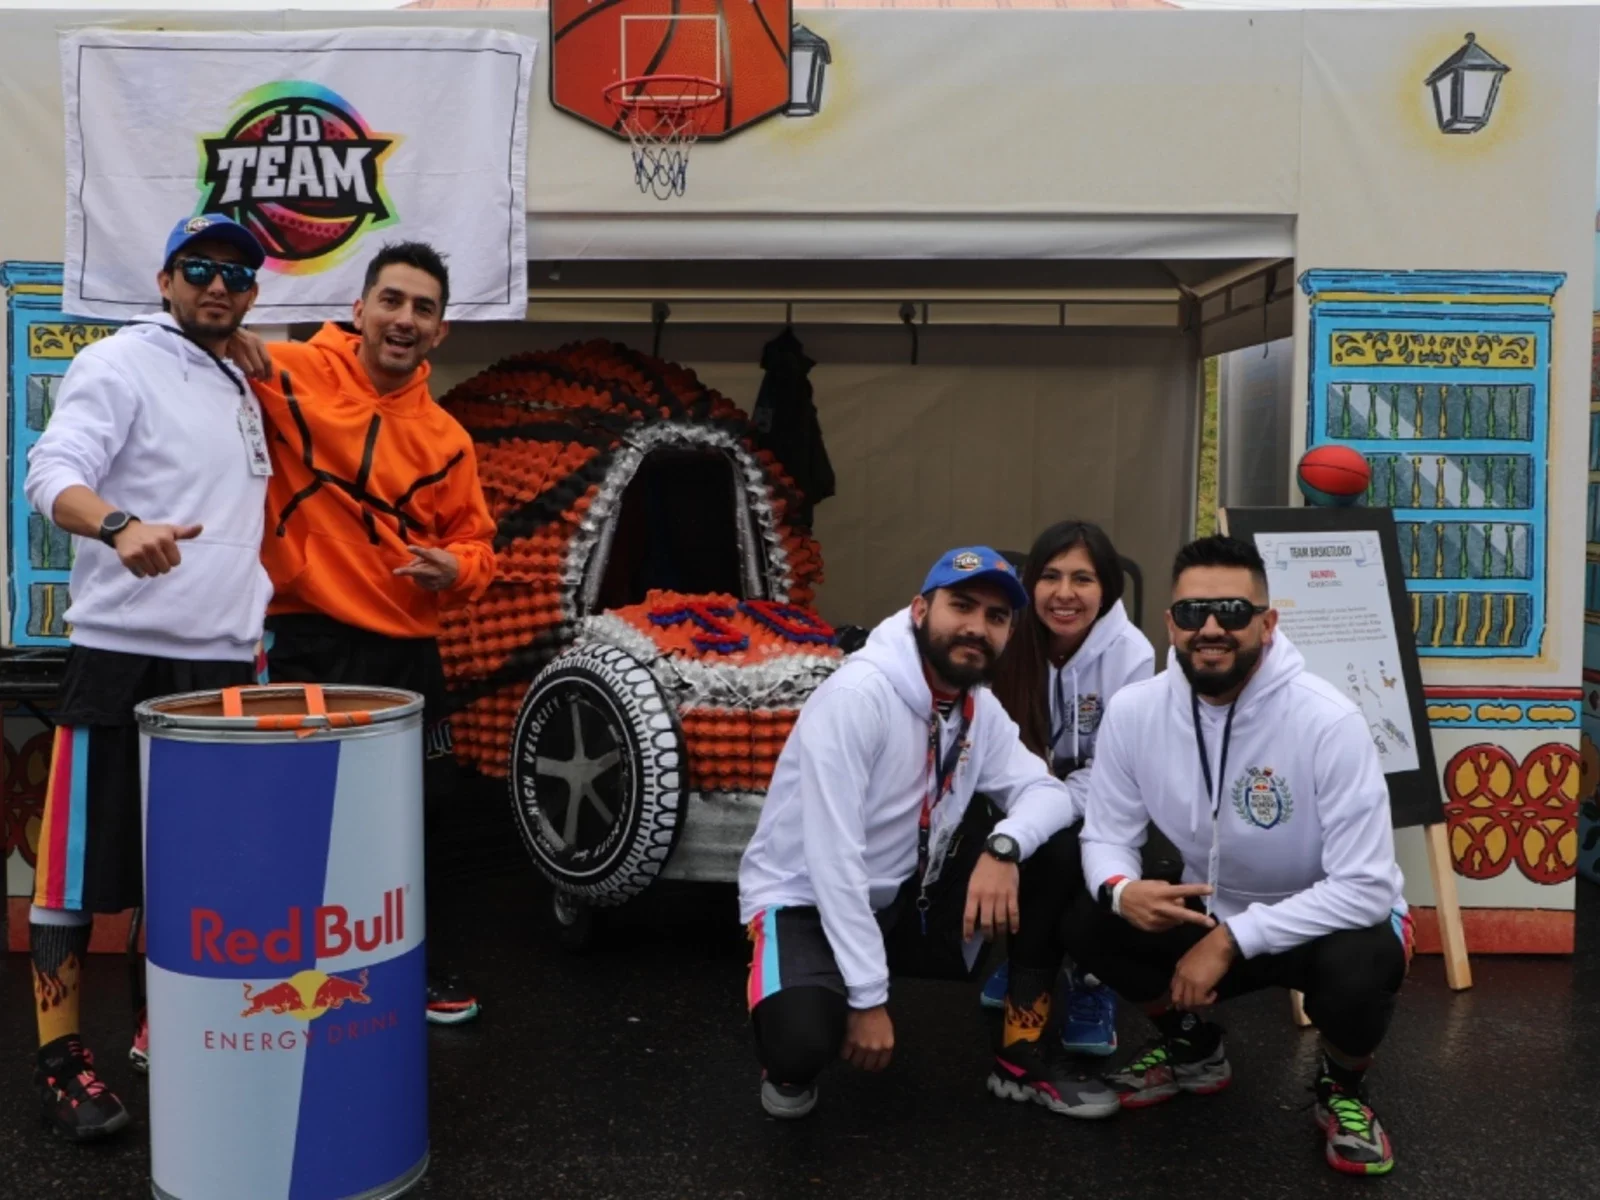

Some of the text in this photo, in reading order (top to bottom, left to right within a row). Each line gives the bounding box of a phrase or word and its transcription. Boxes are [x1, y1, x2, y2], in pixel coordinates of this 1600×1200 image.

[267, 113, 321, 143] JD
[216, 145, 374, 204] TEAM
[523, 695, 562, 817] HIGH VELOCITY
[190, 886, 405, 966] Red Bull
[204, 1009, 398, 1051] ENERGY DRINK
